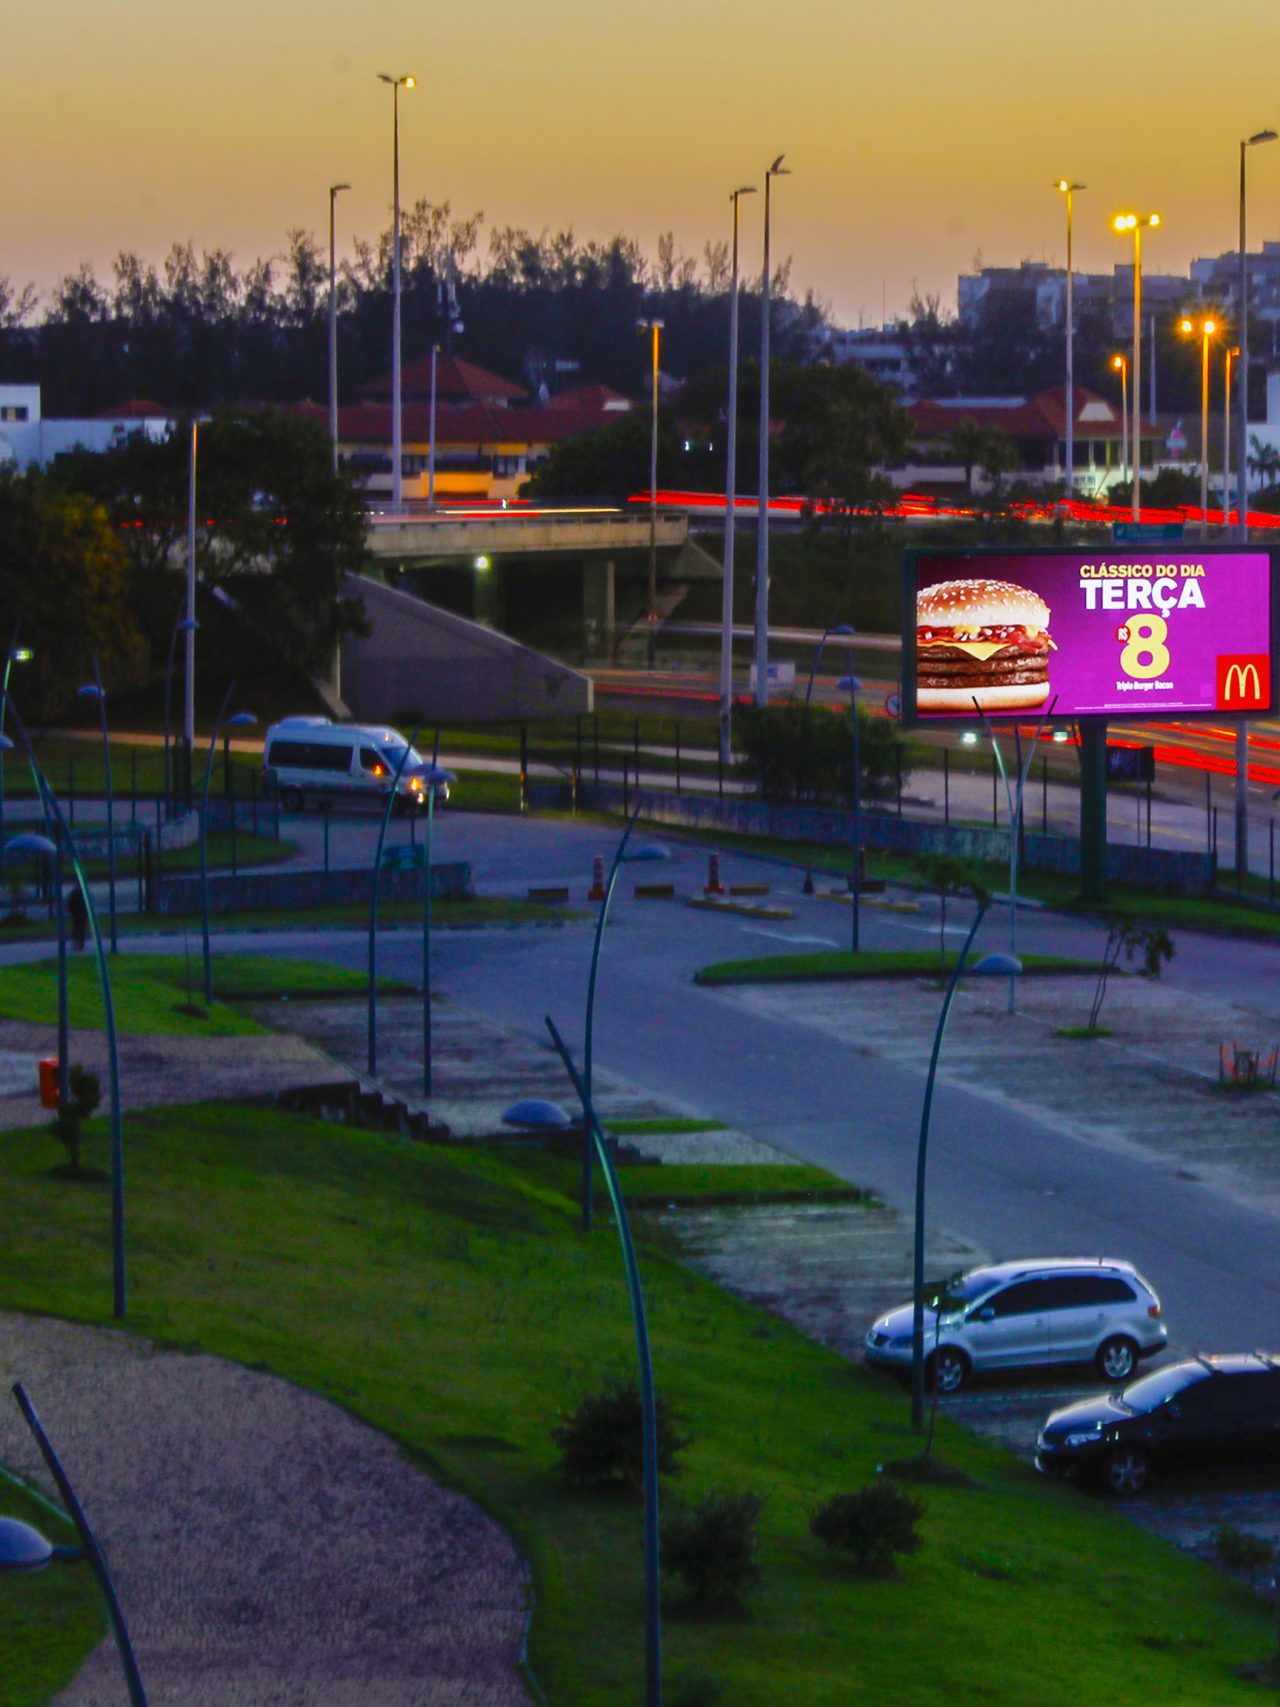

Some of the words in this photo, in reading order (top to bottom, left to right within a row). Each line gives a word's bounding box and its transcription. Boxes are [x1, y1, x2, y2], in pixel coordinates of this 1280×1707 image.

[1080, 563, 1153, 578] CLÁSSICO
[1155, 564, 1178, 578] DO
[1180, 564, 1206, 577] DIA
[1079, 577, 1206, 618] TERÇA
[1120, 613, 1171, 679] 8
[1133, 681, 1154, 692] Burger
[1154, 681, 1174, 690] Bacon
